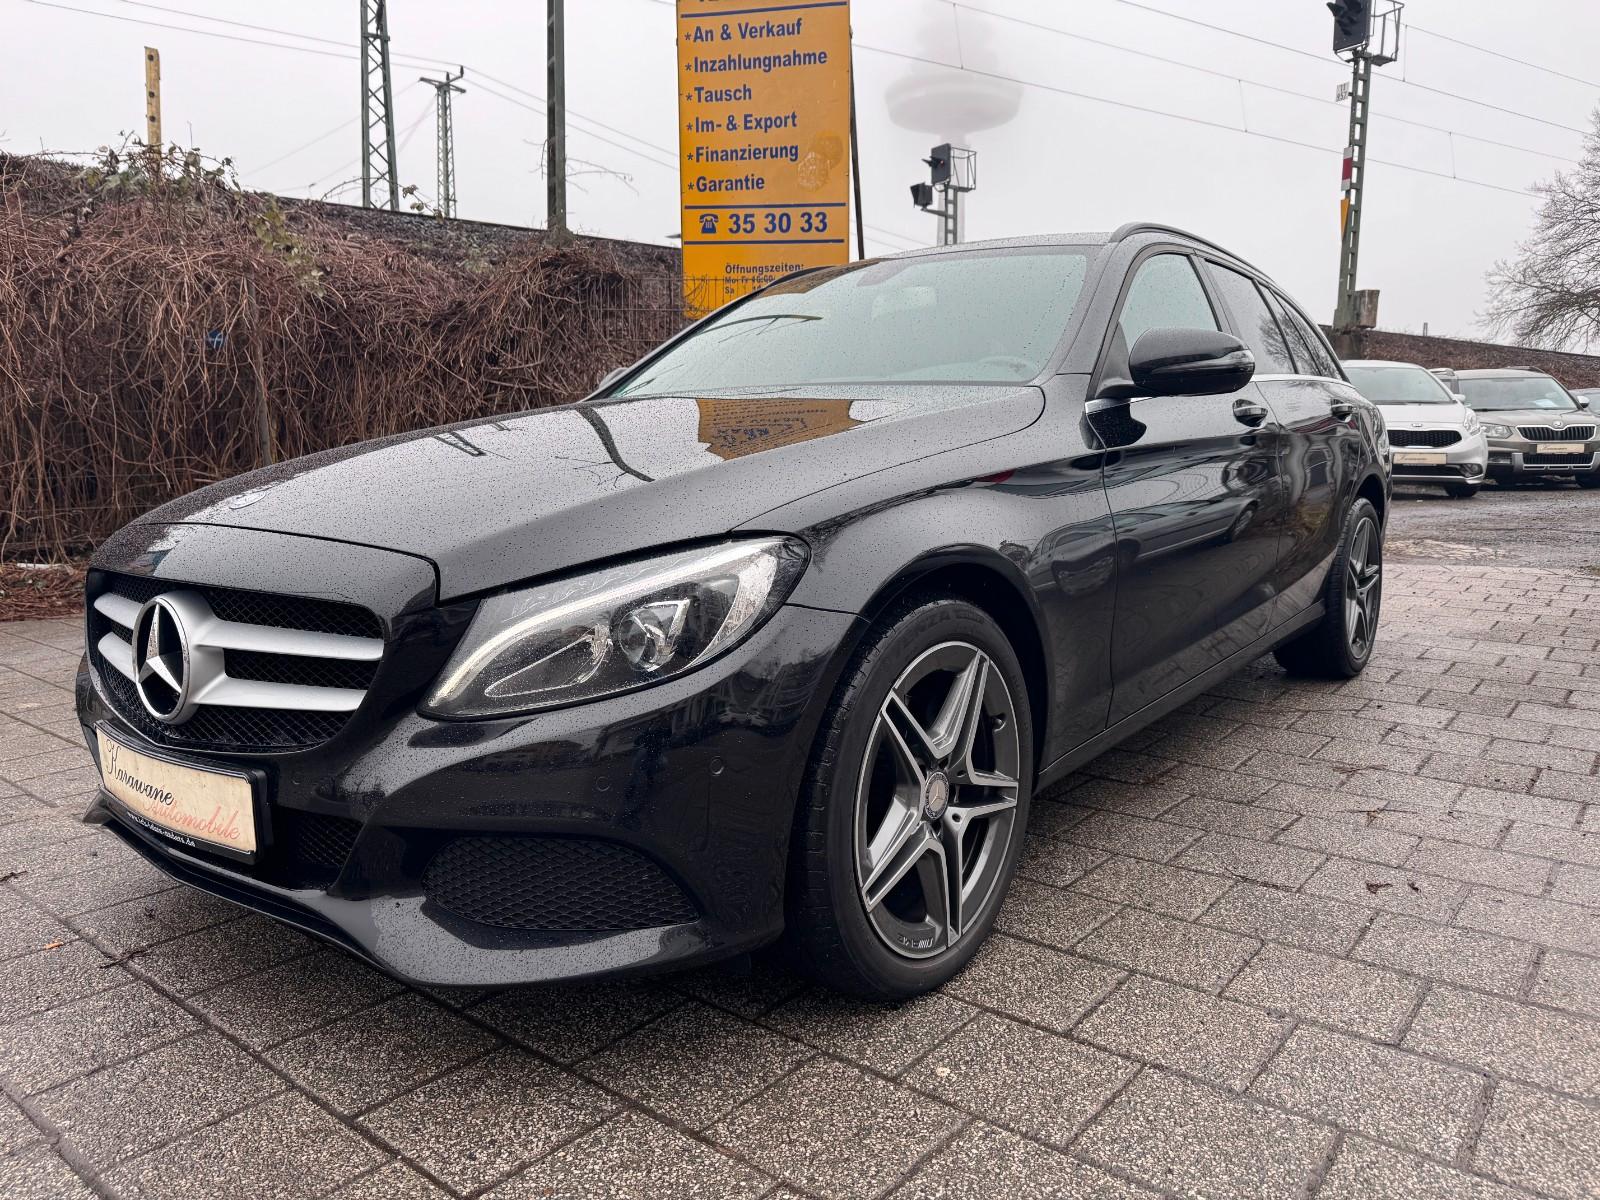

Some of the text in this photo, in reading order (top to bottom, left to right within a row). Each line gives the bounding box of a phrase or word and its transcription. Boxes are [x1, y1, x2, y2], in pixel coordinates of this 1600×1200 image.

[693, 18, 803, 43] An & Verkauf
[694, 50, 828, 73] Inzahlungnahme
[694, 84, 752, 103] Tausch
[695, 111, 797, 133] Im- & Export
[695, 144, 799, 163] Finanzierung
[696, 174, 765, 192] Garantie
[728, 212, 827, 234] 35 30 33
[725, 262, 804, 275] Öffnungszeiten:
[105, 738, 175, 806] Karawane
